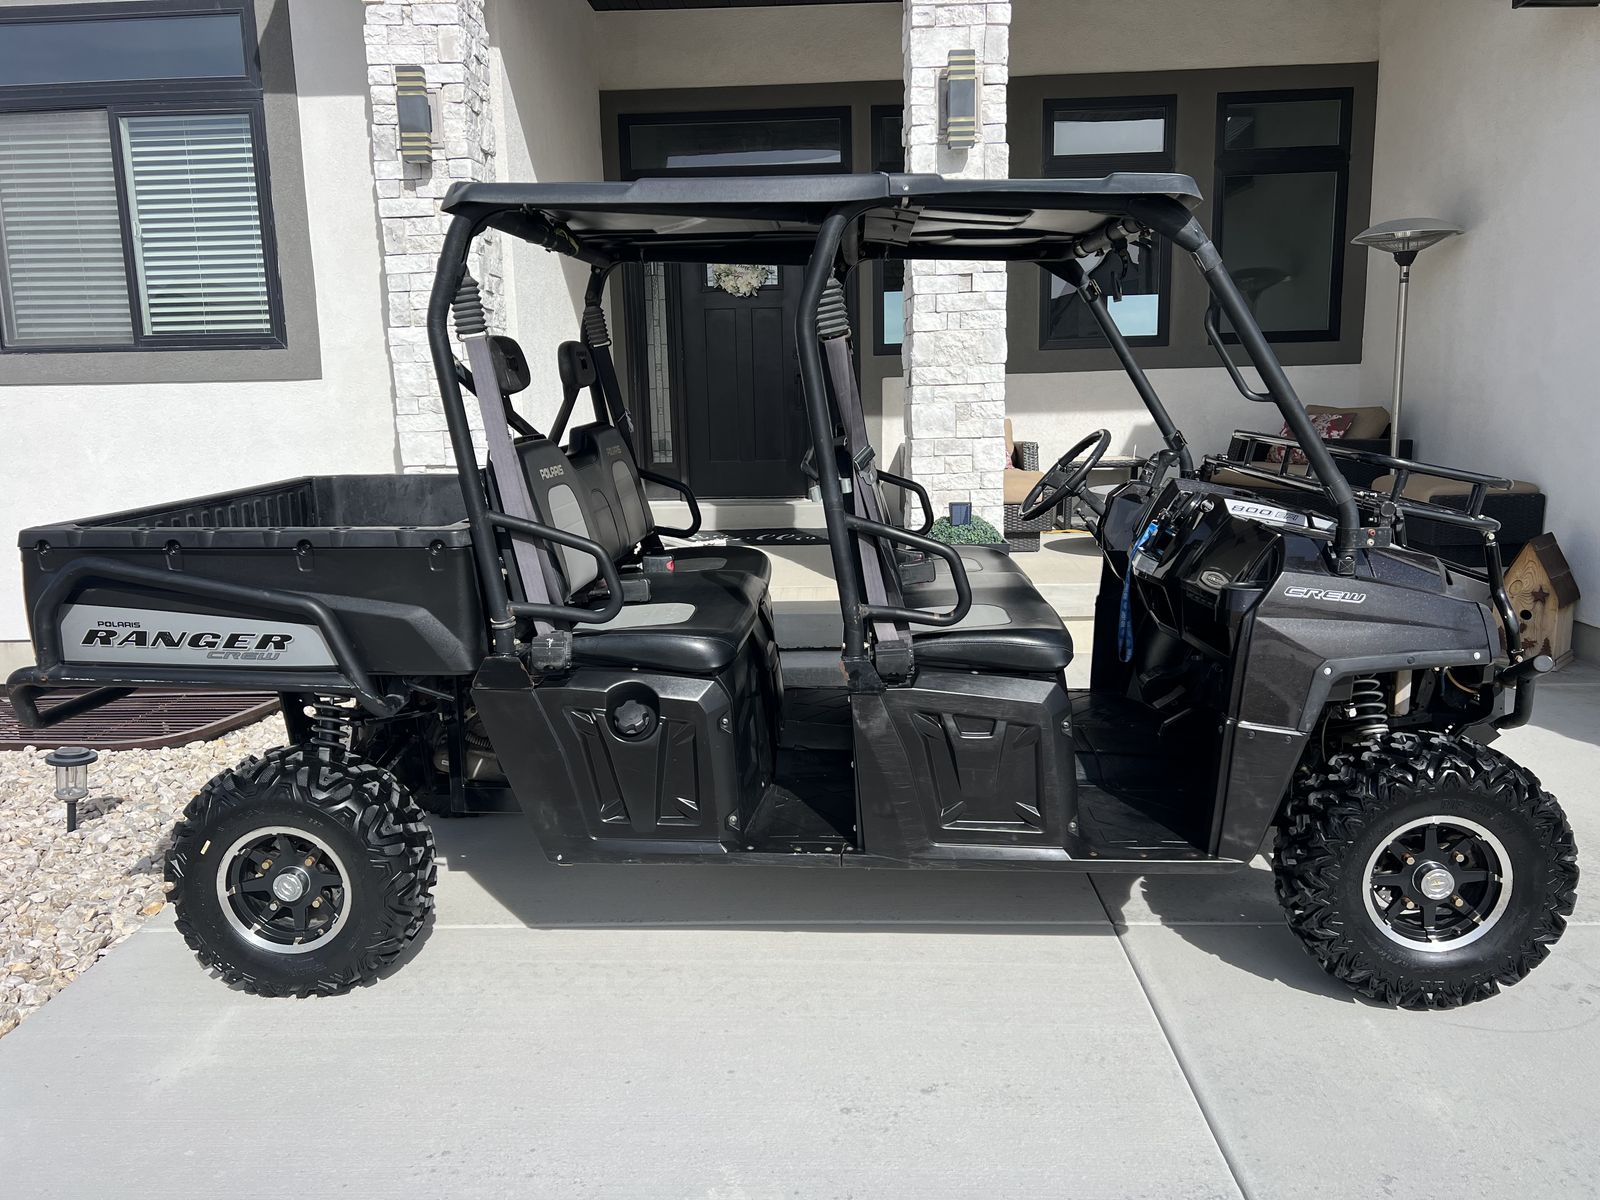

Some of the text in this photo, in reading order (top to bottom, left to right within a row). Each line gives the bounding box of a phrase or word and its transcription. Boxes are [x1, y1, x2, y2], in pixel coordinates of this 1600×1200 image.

[539, 464, 565, 480] POLARIS
[1232, 504, 1273, 516] 800
[1284, 585, 1367, 604] CREW
[97, 620, 141, 629] POLARIS
[80, 628, 295, 652] RANGER
[206, 650, 281, 661] CREW
